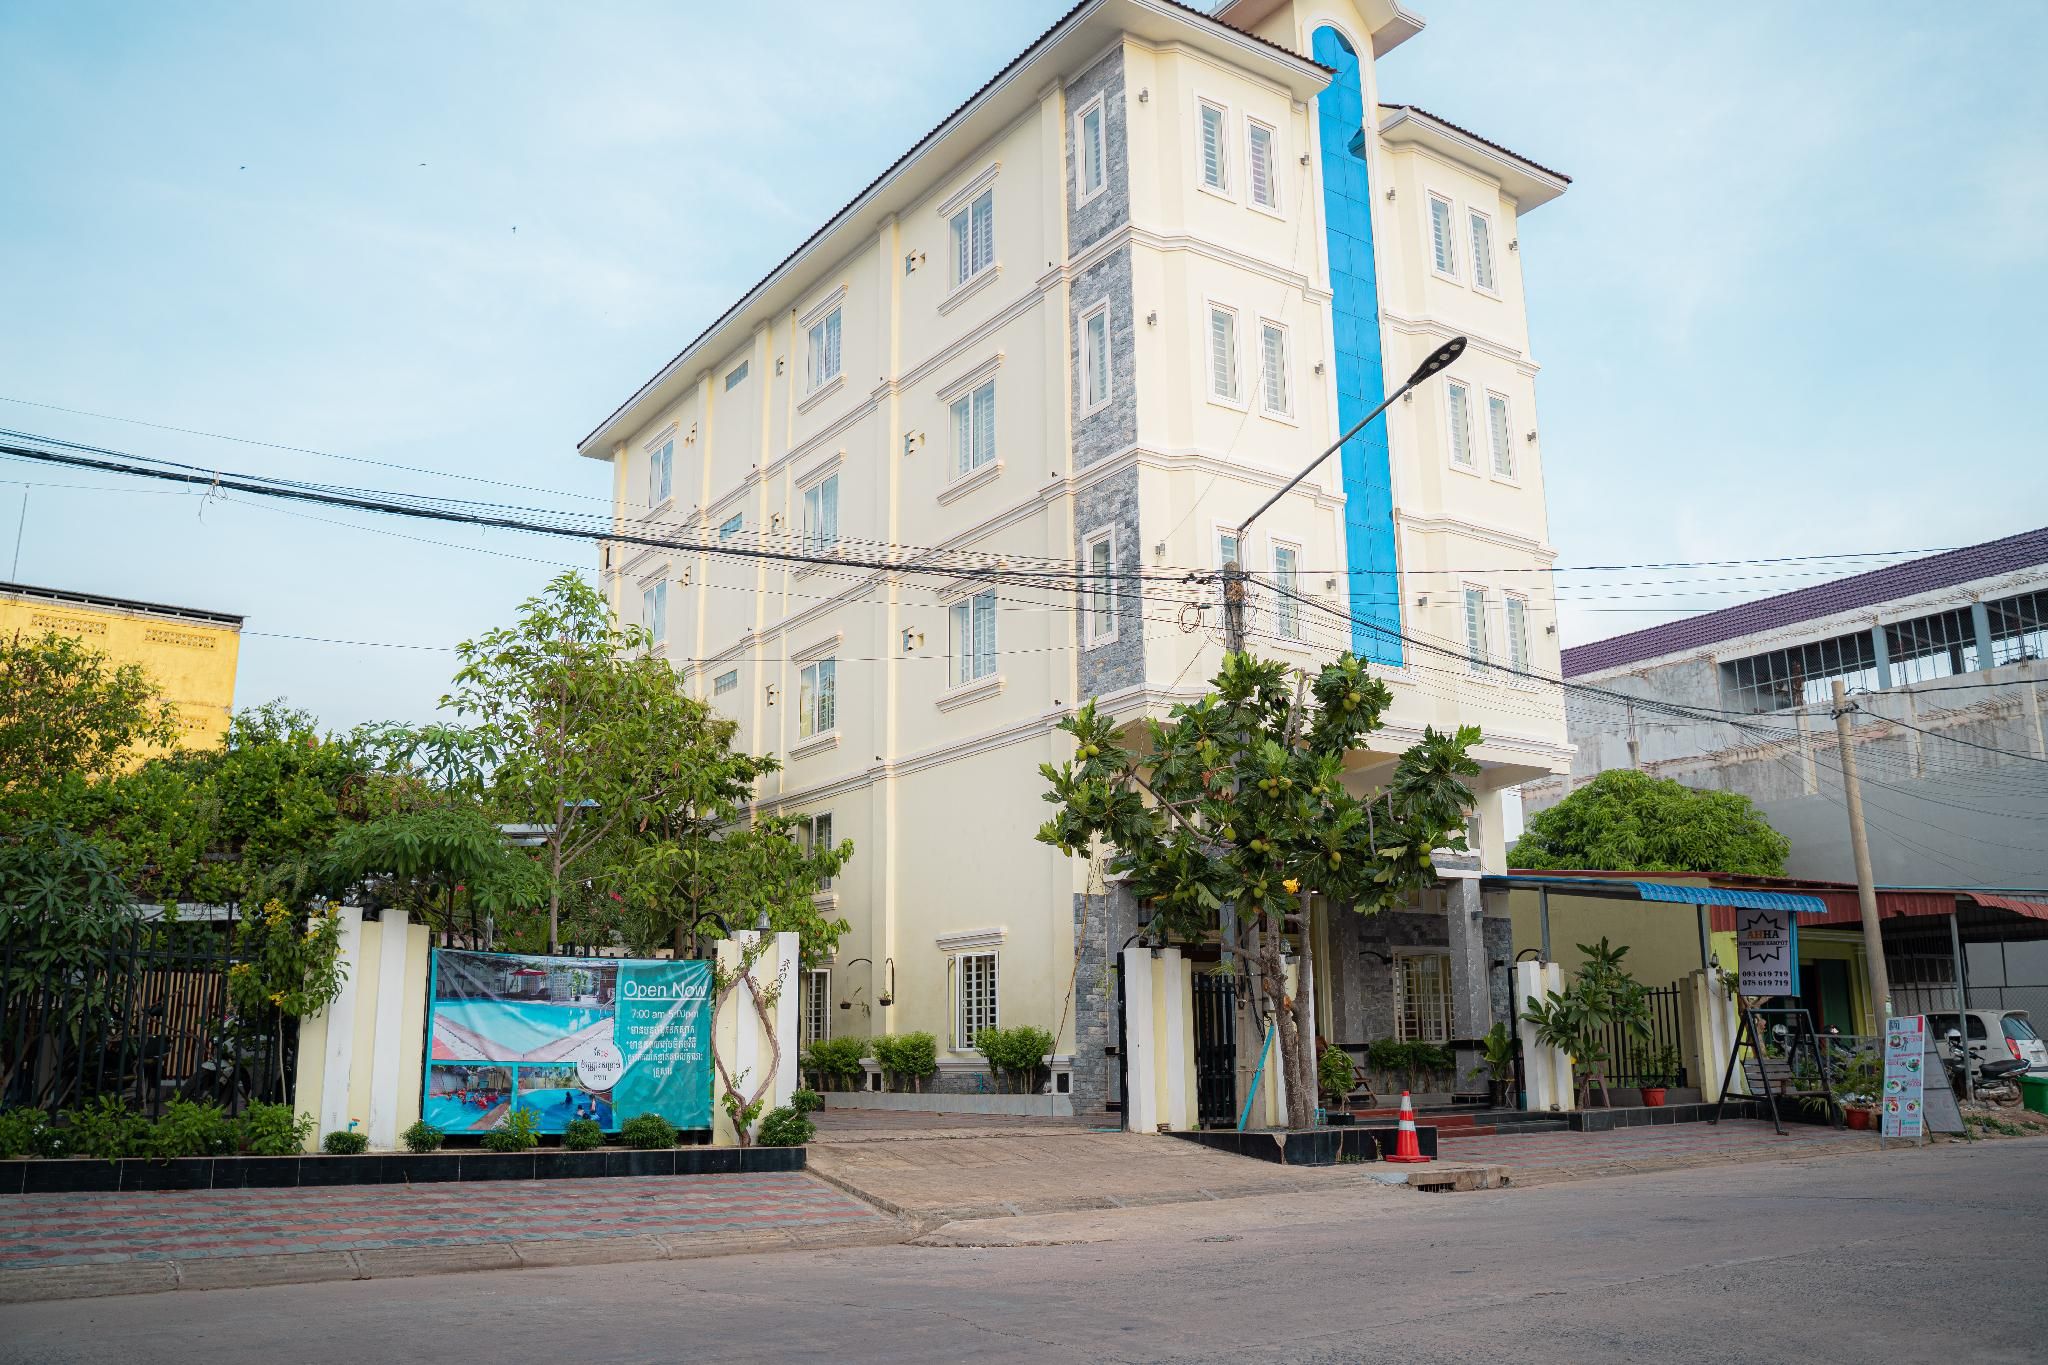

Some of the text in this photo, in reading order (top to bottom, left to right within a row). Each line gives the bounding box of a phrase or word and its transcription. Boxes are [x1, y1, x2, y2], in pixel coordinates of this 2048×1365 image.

[624, 980, 708, 999] Open Now
[631, 1009, 650, 1019] 7:00
[652, 1010, 665, 1019] am
